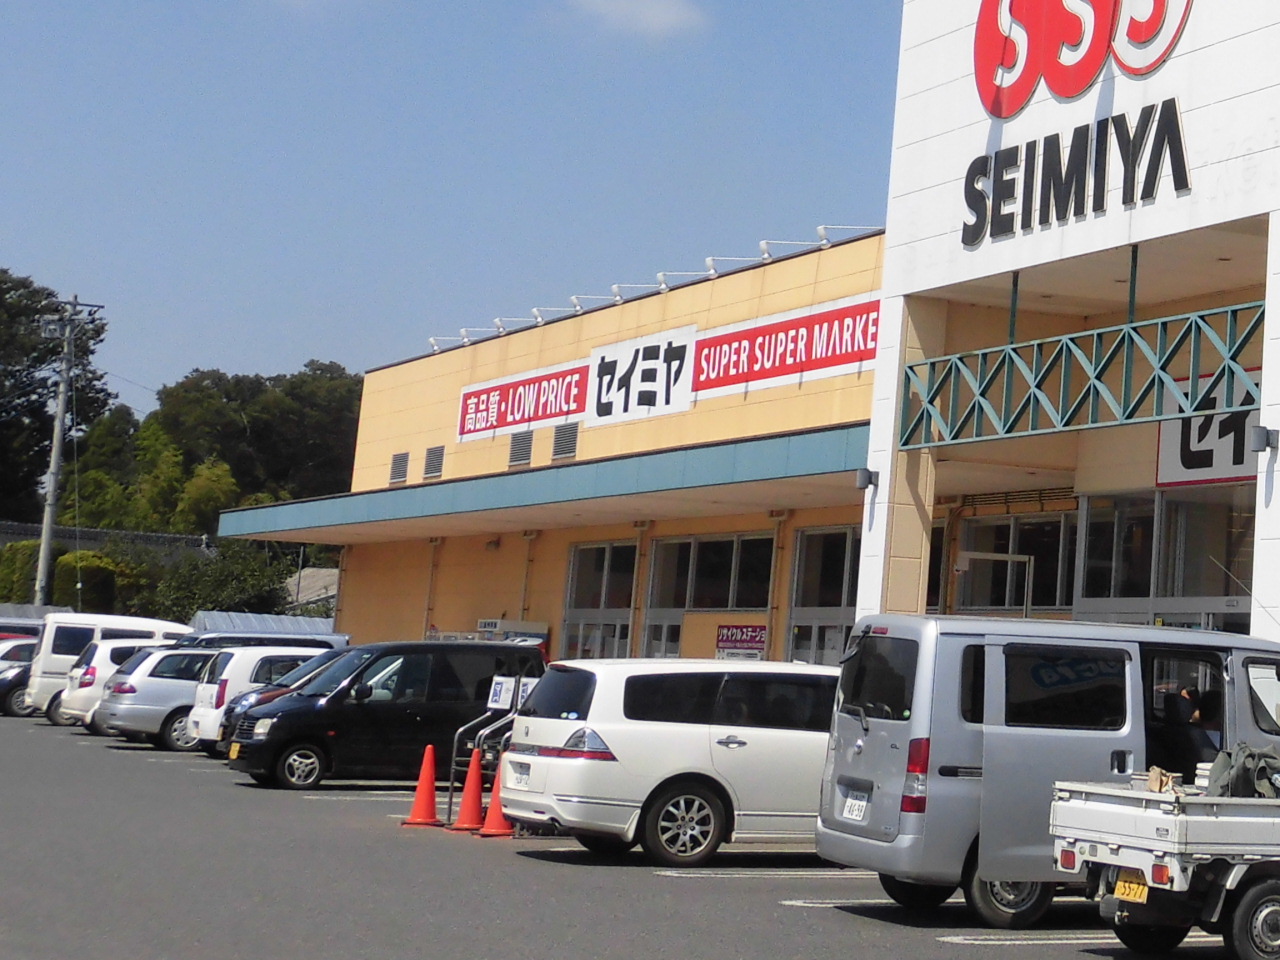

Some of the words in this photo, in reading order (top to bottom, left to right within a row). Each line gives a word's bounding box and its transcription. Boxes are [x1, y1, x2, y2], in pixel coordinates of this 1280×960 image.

[961, 96, 1191, 248] SEIMIYA
[596, 340, 688, 418] セイミヤ
[699, 340, 750, 382] SUPER
[753, 327, 808, 372] SUPER
[811, 311, 878, 360] MARKE
[538, 373, 580, 416] PRICE
[1178, 382, 1260, 470] セイ
[718, 627, 766, 641] リサイクルステーショ
